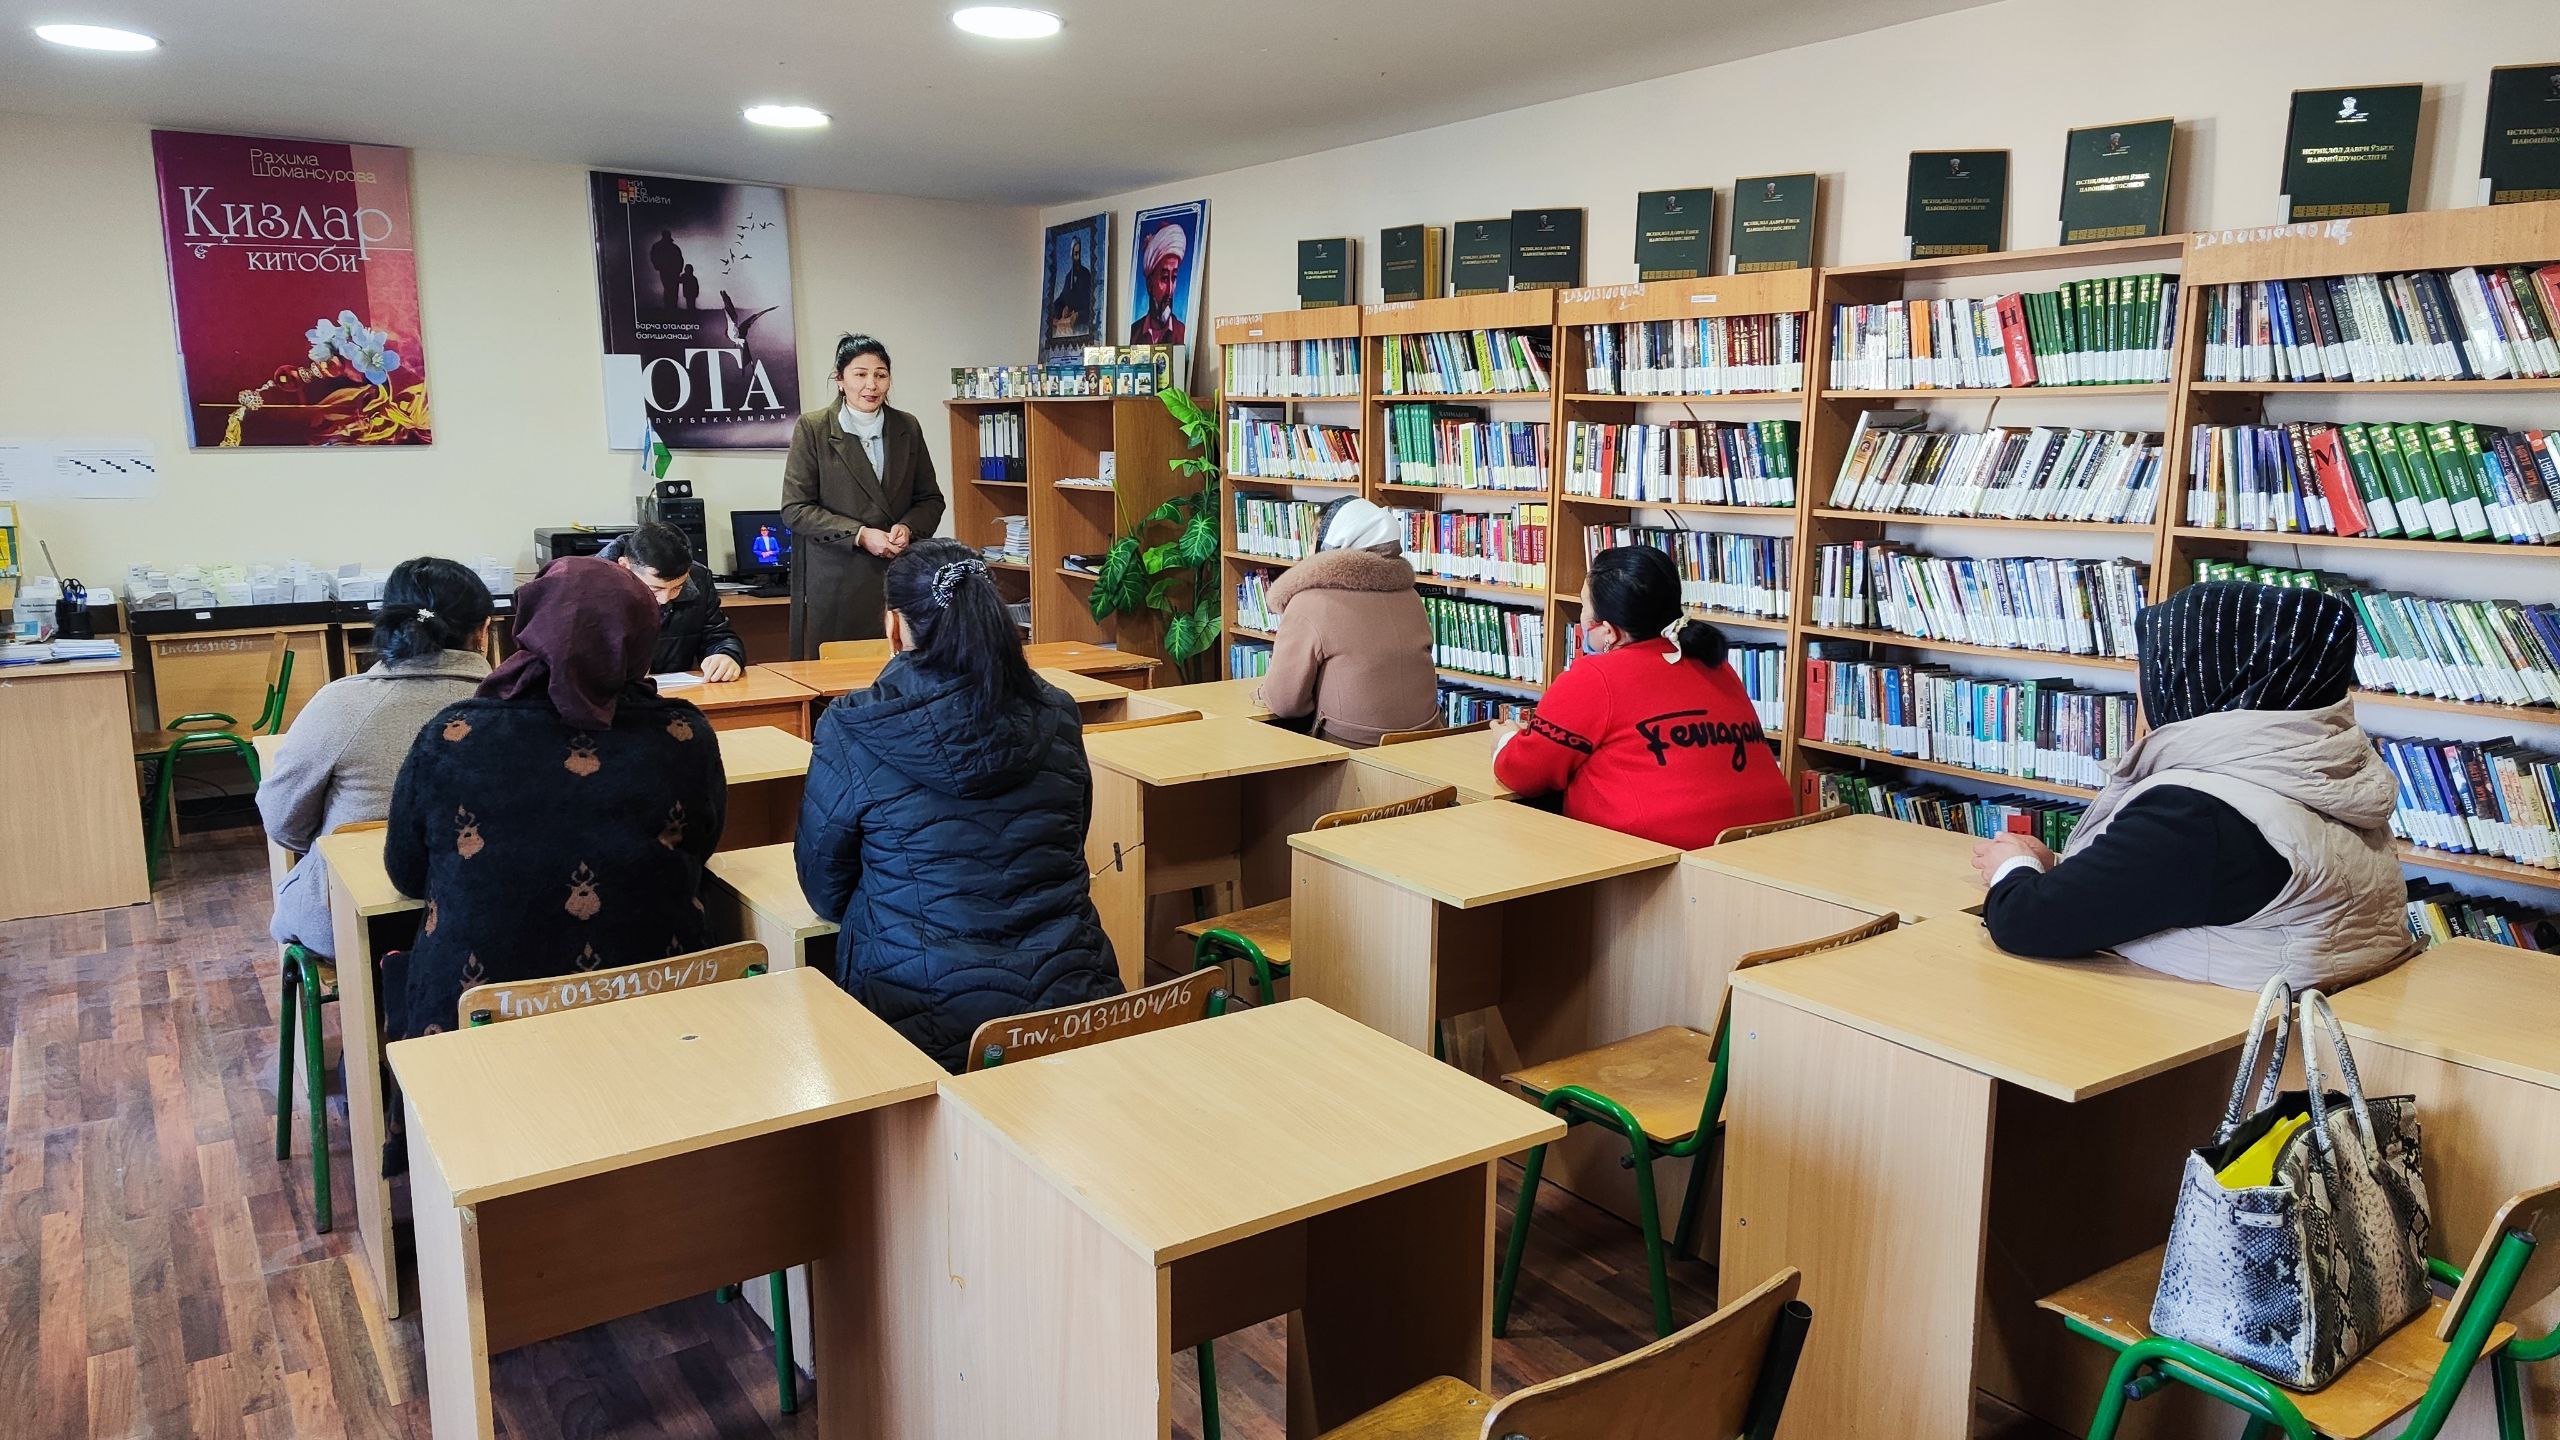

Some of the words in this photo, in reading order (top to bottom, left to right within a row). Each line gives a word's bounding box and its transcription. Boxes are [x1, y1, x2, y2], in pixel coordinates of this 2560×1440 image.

[250, 149, 319, 167] Рахима
[252, 159, 377, 184] Шомансурова
[246, 244, 359, 273] китоби
[642, 348, 785, 413] ОТА
